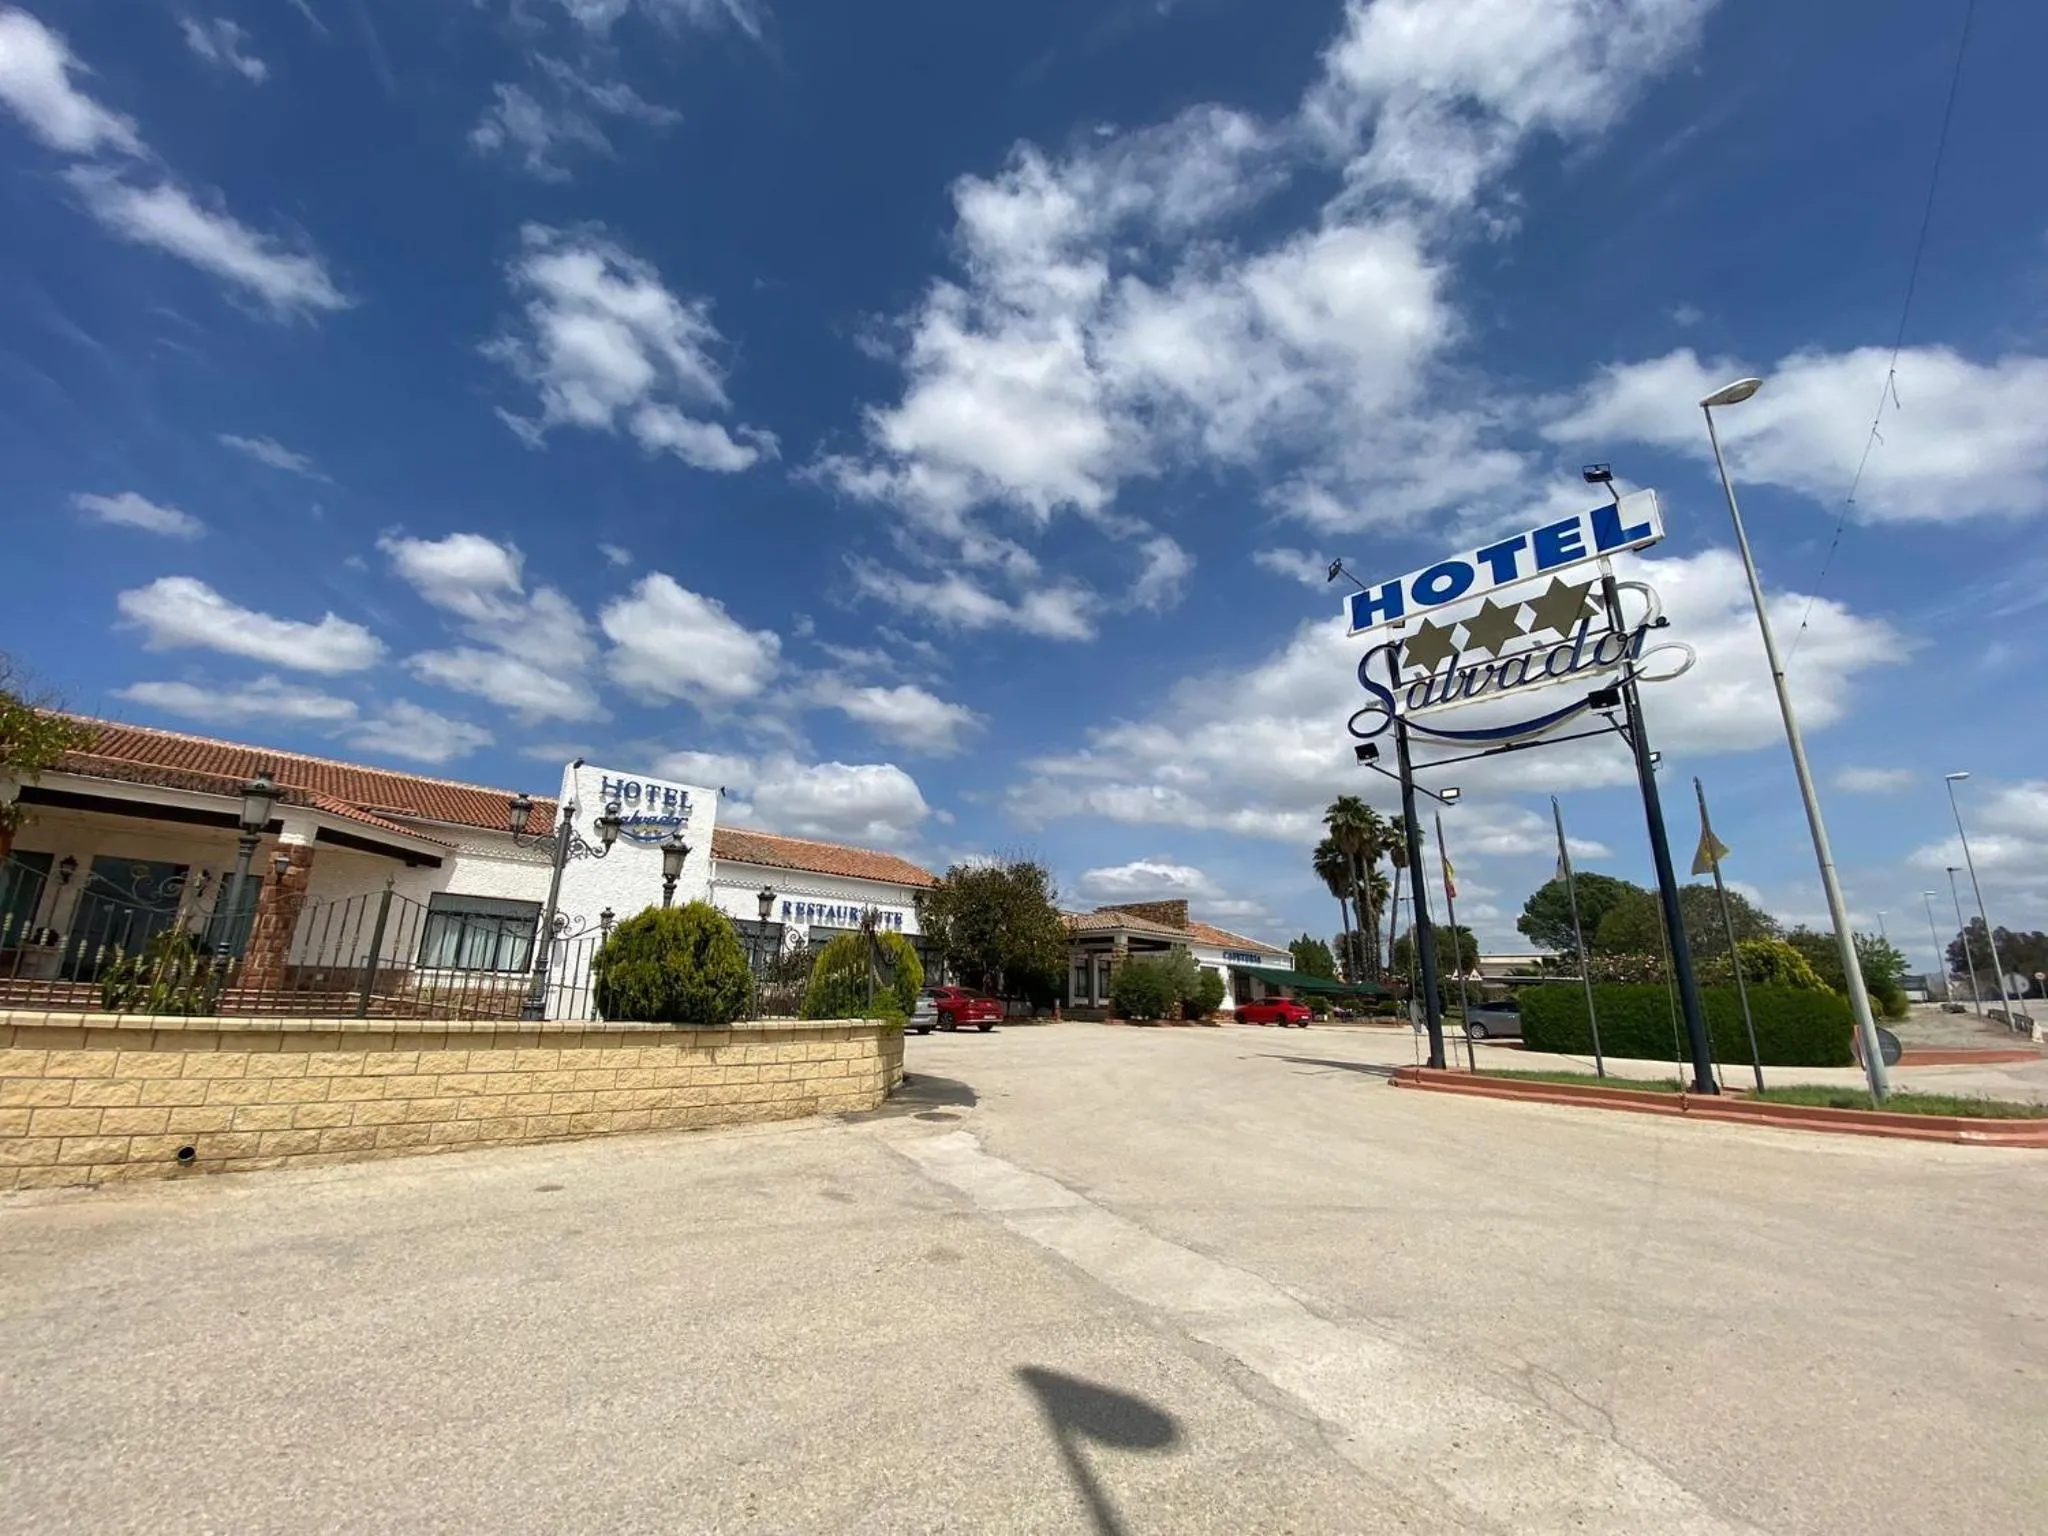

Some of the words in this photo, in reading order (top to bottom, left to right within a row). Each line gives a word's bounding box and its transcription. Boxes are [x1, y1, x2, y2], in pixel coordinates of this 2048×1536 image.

[1352, 503, 1652, 631] HOTEL
[1348, 612, 1670, 738] Salvador
[602, 776, 693, 809] HOTEL
[781, 900, 904, 926] RESTAURTE
